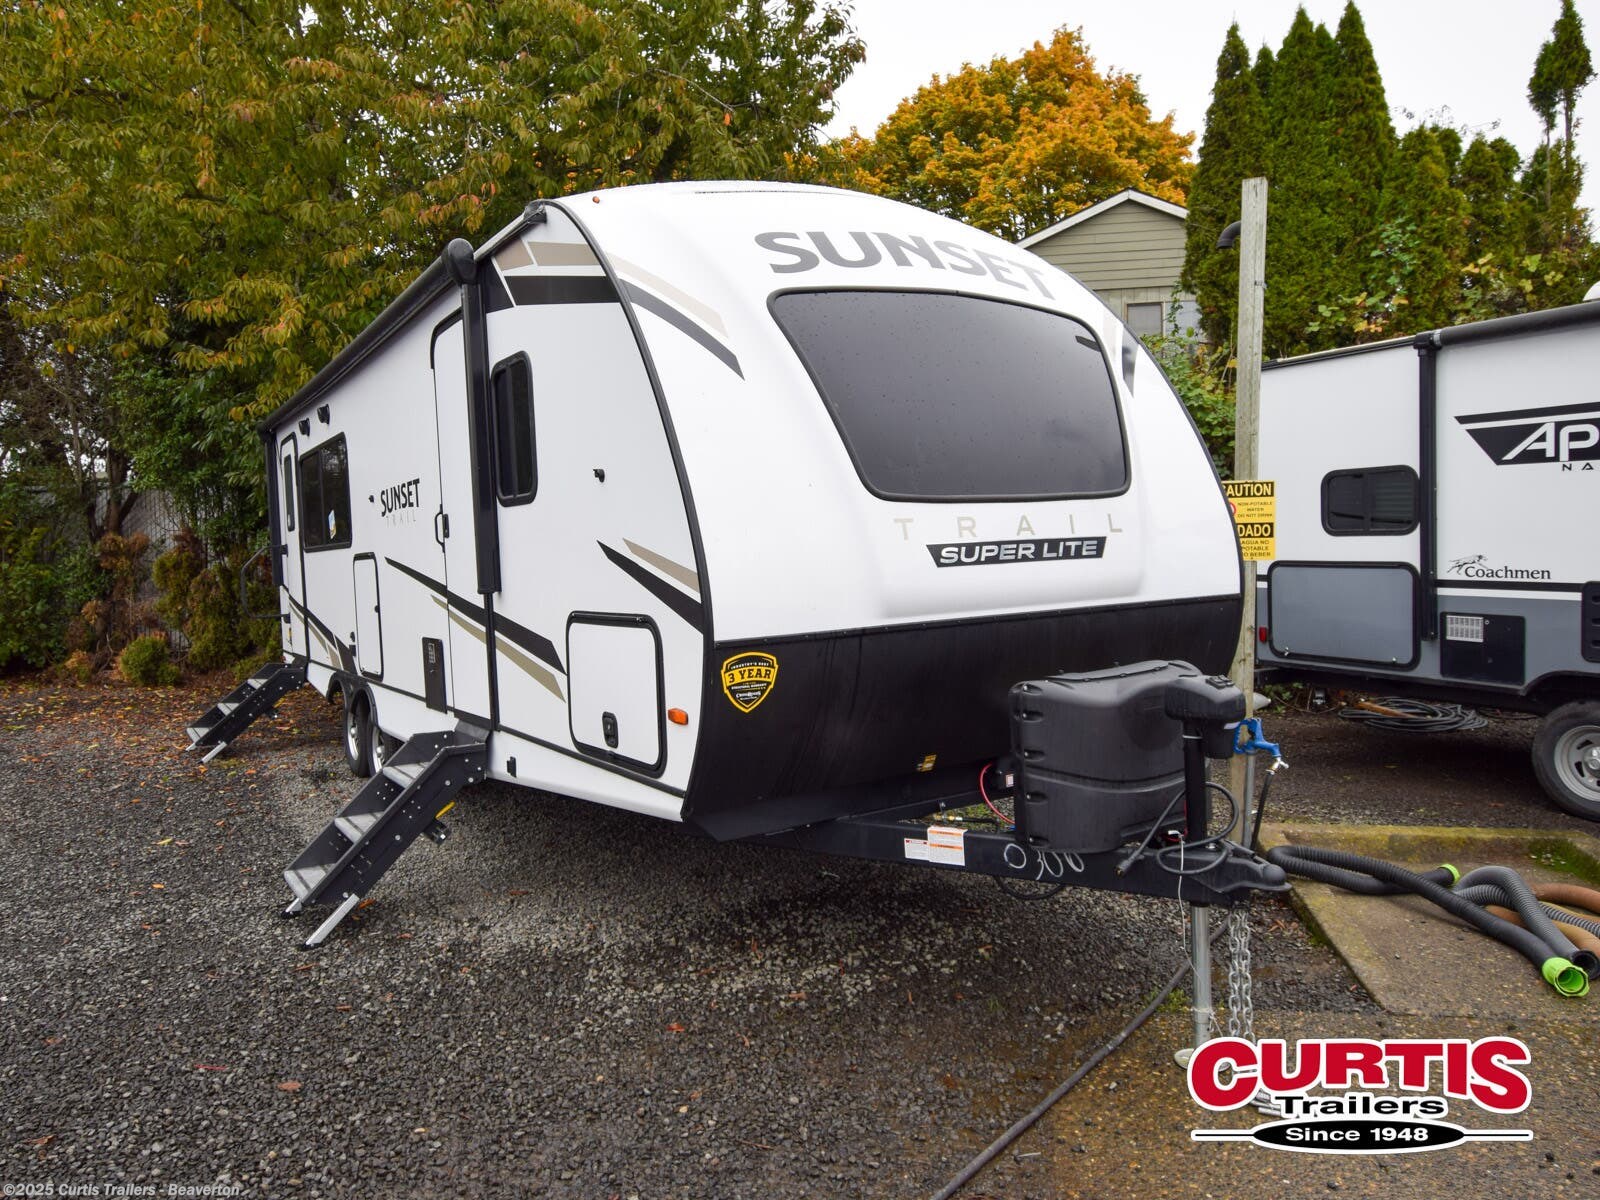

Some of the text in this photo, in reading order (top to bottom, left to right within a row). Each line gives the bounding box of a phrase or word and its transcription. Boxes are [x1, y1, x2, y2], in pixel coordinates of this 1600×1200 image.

[754, 231, 1055, 300] SUNSET
[380, 478, 420, 517] SUNSET
[1222, 483, 1272, 497] AUTION
[386, 509, 417, 528] TRAIL
[893, 513, 1123, 541] TRAIL
[940, 540, 1098, 564] SUPER LITE
[1464, 565, 1551, 580] Coachmen
[728, 668, 772, 683] 3 YEAR
